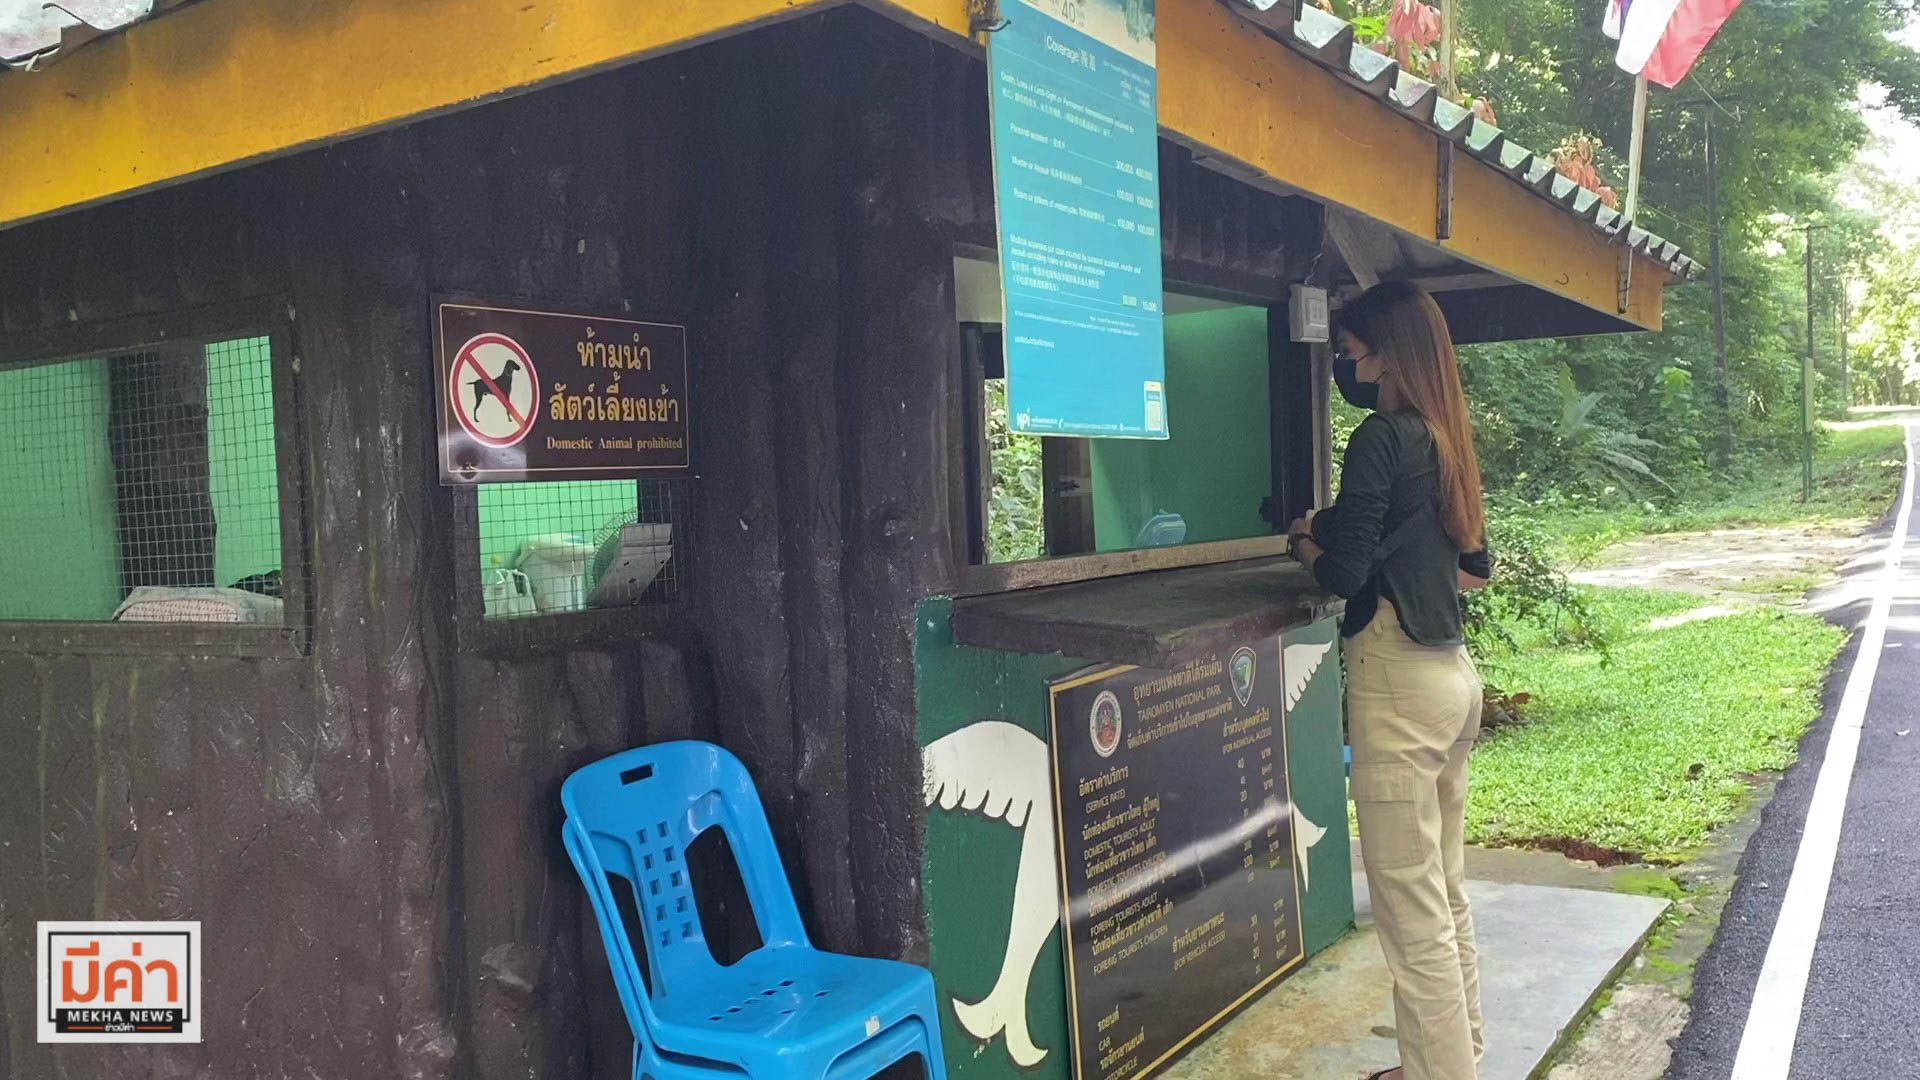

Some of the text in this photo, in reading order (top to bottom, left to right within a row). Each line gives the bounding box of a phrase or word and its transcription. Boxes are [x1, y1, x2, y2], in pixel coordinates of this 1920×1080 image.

[1046, 35, 1080, 63] Coverage
[577, 326, 651, 371] ห้ามนำ
[549, 371, 679, 422] สัตว์เลี้ยงเข้า
[547, 437, 682, 452] Domestic Animal prohibited
[1175, 690, 1206, 709] NATIONAL
[1206, 683, 1222, 698] PARK
[1079, 766, 1128, 797] อัตราค่าบริการ
[1099, 1036, 1111, 1051] CAR
